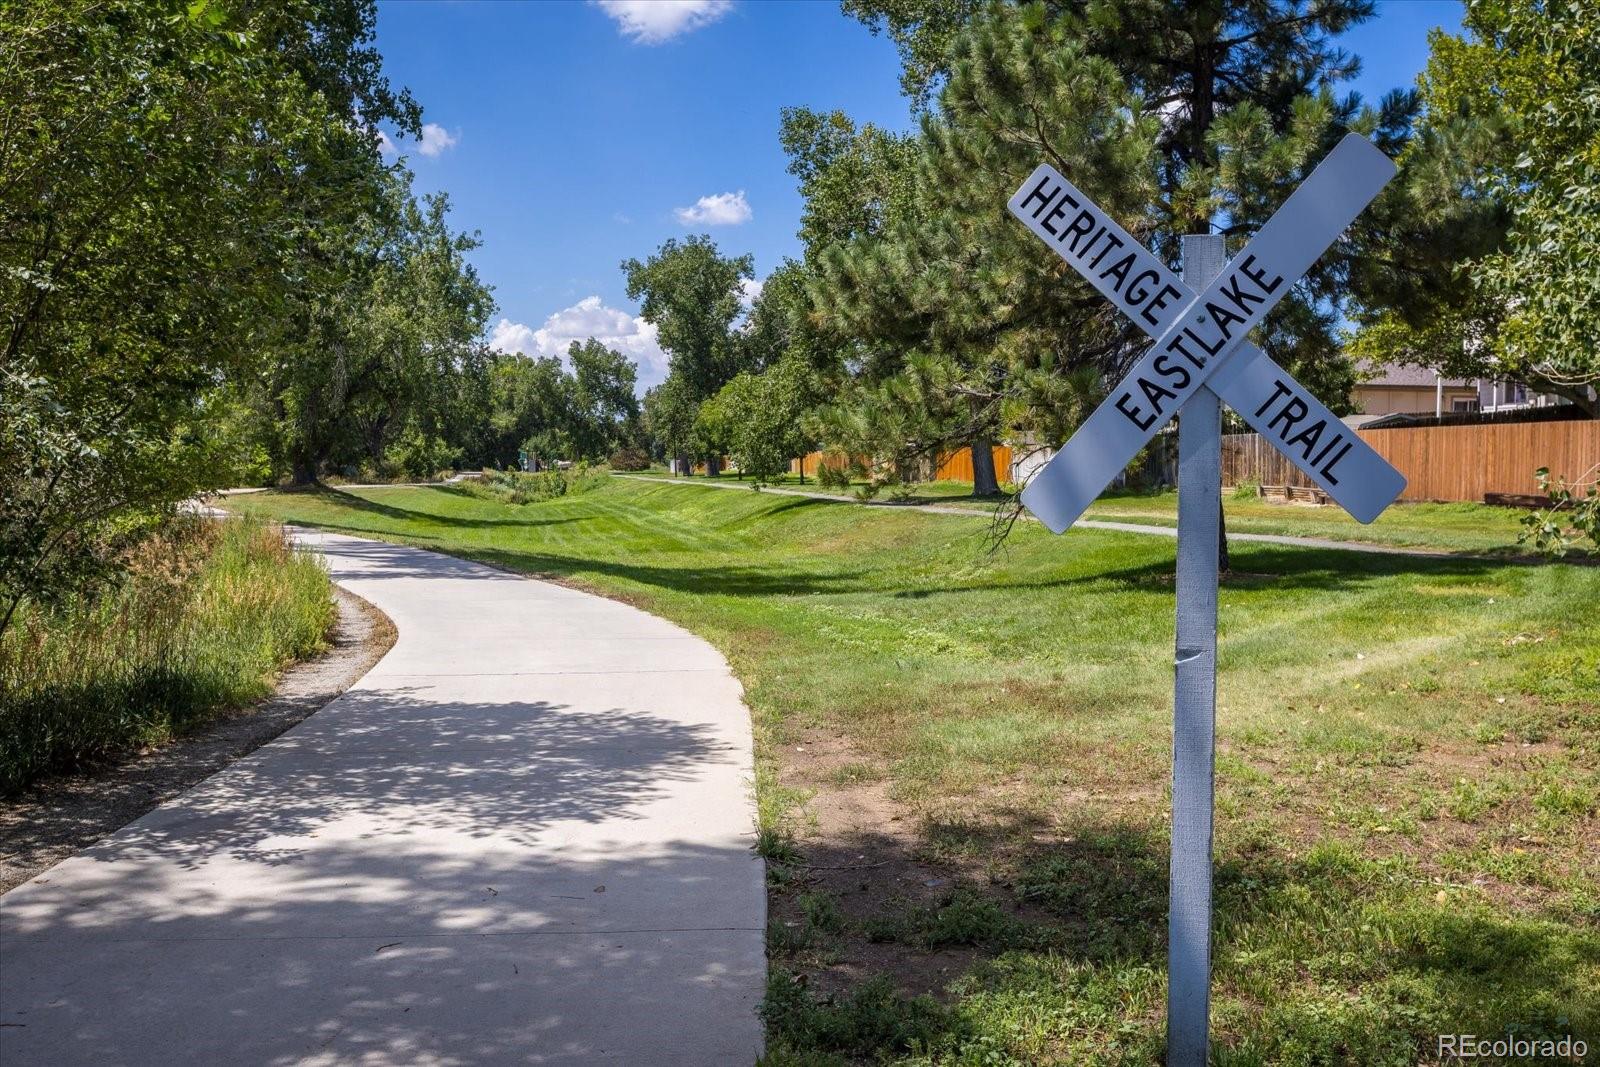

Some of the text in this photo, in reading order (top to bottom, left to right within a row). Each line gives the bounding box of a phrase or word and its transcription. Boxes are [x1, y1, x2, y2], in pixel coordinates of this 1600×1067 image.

[1020, 176, 1353, 486] HERITAGE TRAIL
[1115, 255, 1283, 432] EASTLAKE
